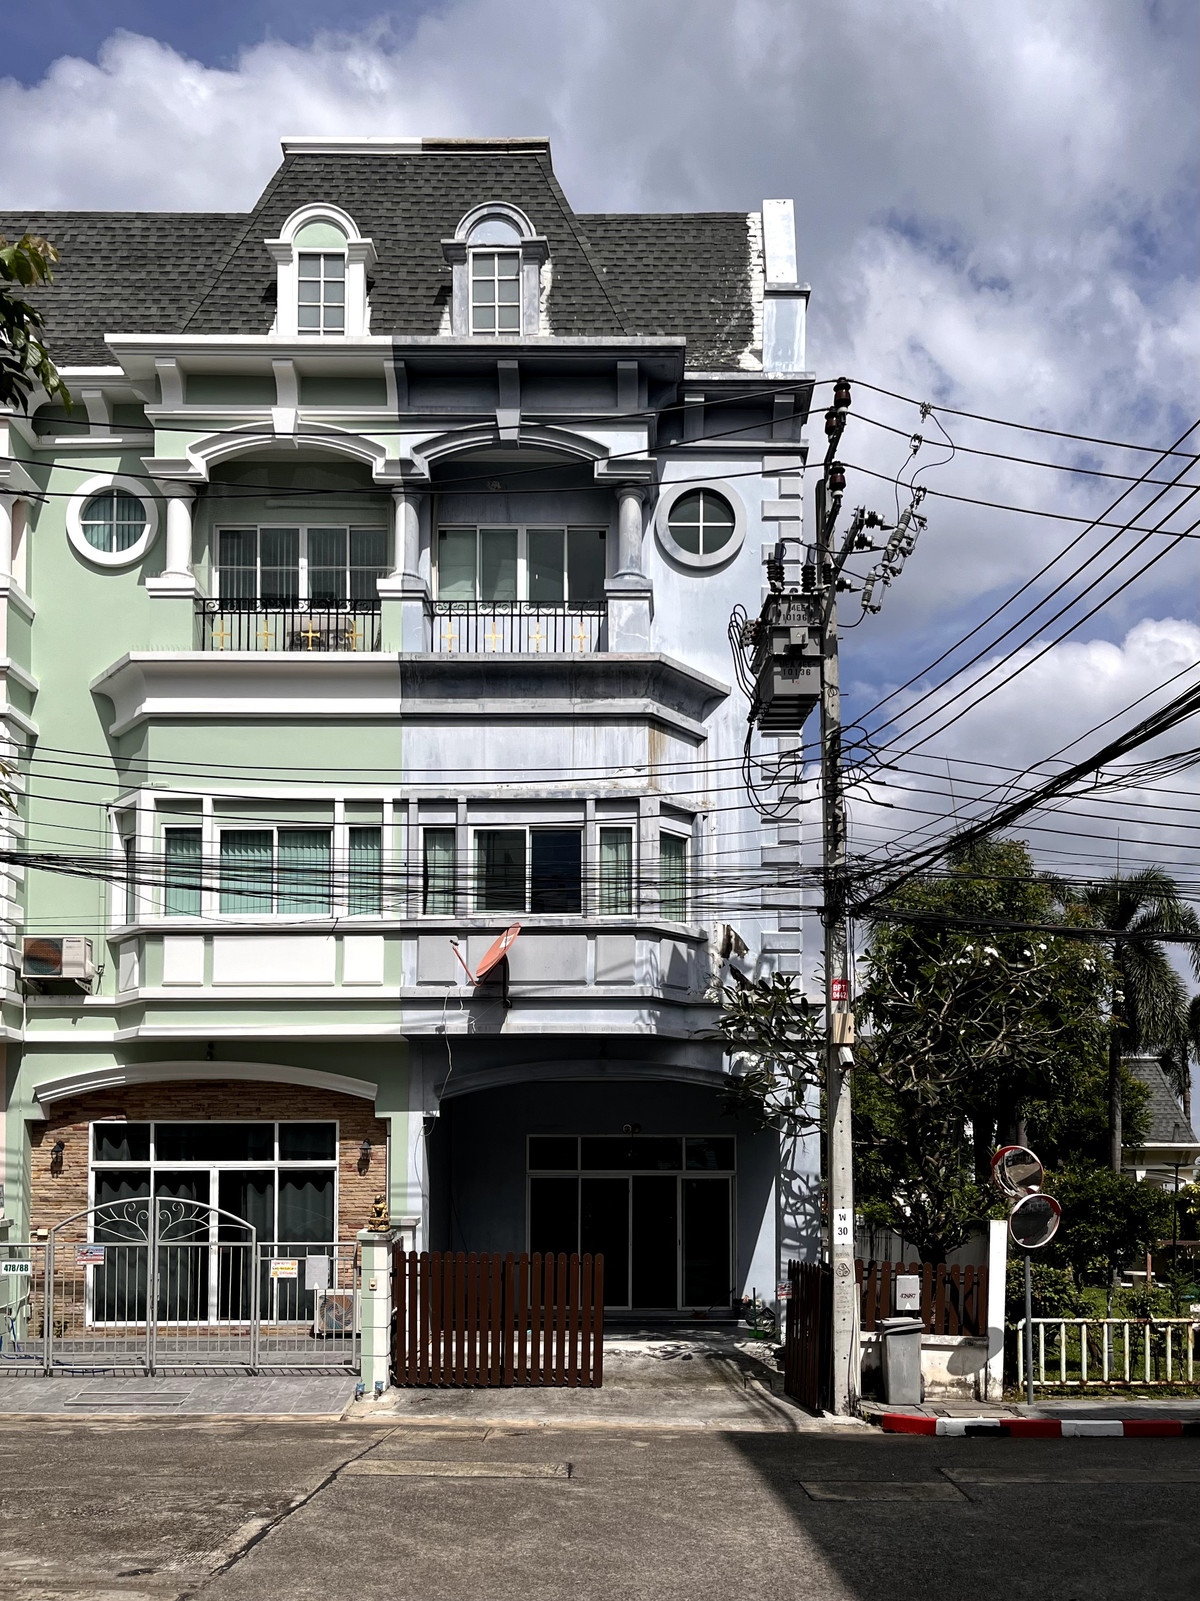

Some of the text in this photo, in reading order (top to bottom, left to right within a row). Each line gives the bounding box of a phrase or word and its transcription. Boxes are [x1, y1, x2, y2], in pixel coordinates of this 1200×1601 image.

[782, 613, 807, 621] 10136
[783, 668, 811, 676] 10136
[837, 1226, 848, 1236] 30
[3, 1264, 29, 1272] 478/88
